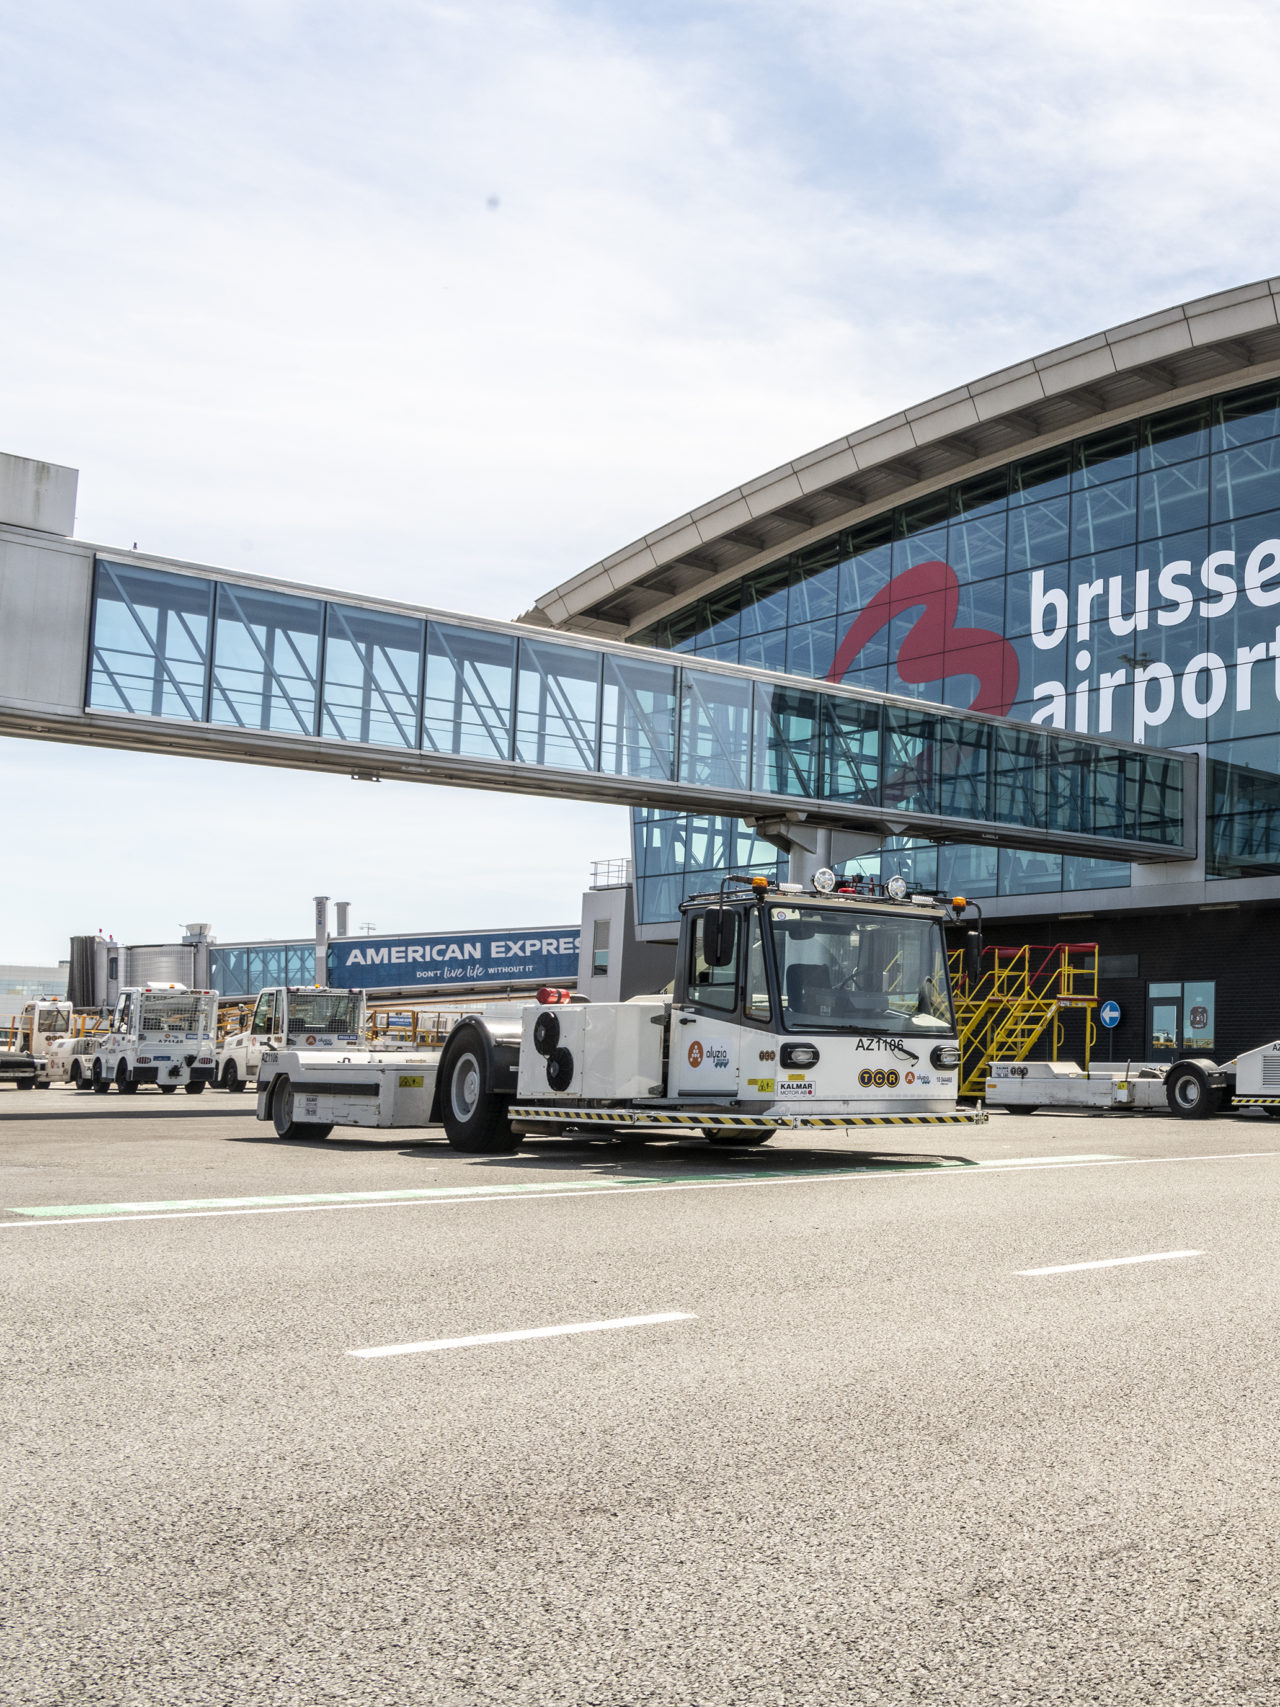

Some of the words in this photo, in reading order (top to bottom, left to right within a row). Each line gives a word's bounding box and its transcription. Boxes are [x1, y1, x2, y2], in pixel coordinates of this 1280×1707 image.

[345, 943, 481, 966] AMERICAN
[416, 970, 441, 978] DON'T
[443, 965, 465, 979] live
[466, 964, 487, 979] life
[488, 965, 524, 975] WITHOUT
[525, 965, 533, 973] IT
[856, 1038, 904, 1051] AZ1106
[705, 1045, 727, 1063] alyzia
[861, 1071, 897, 1085] TCR
